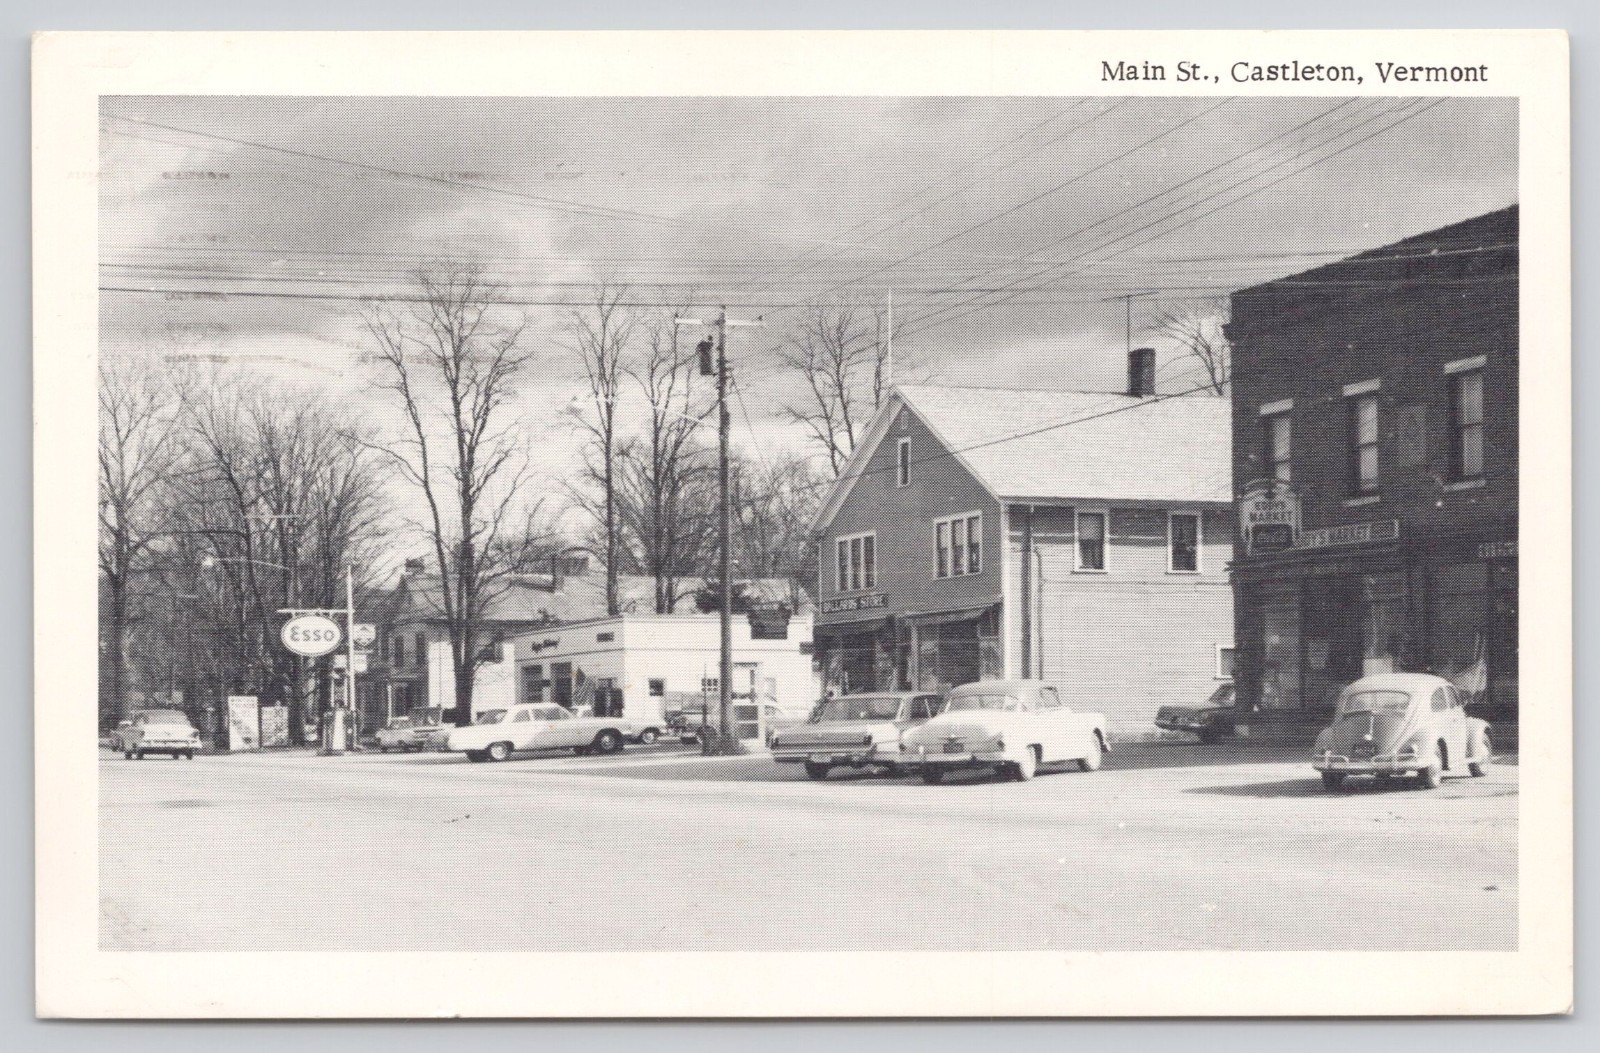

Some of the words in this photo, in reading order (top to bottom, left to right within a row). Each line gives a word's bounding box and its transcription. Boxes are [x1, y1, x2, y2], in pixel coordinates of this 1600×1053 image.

[1249, 511, 1293, 522] MARKET
[1328, 524, 1368, 543] MARKET
[290, 625, 335, 641] Esso
